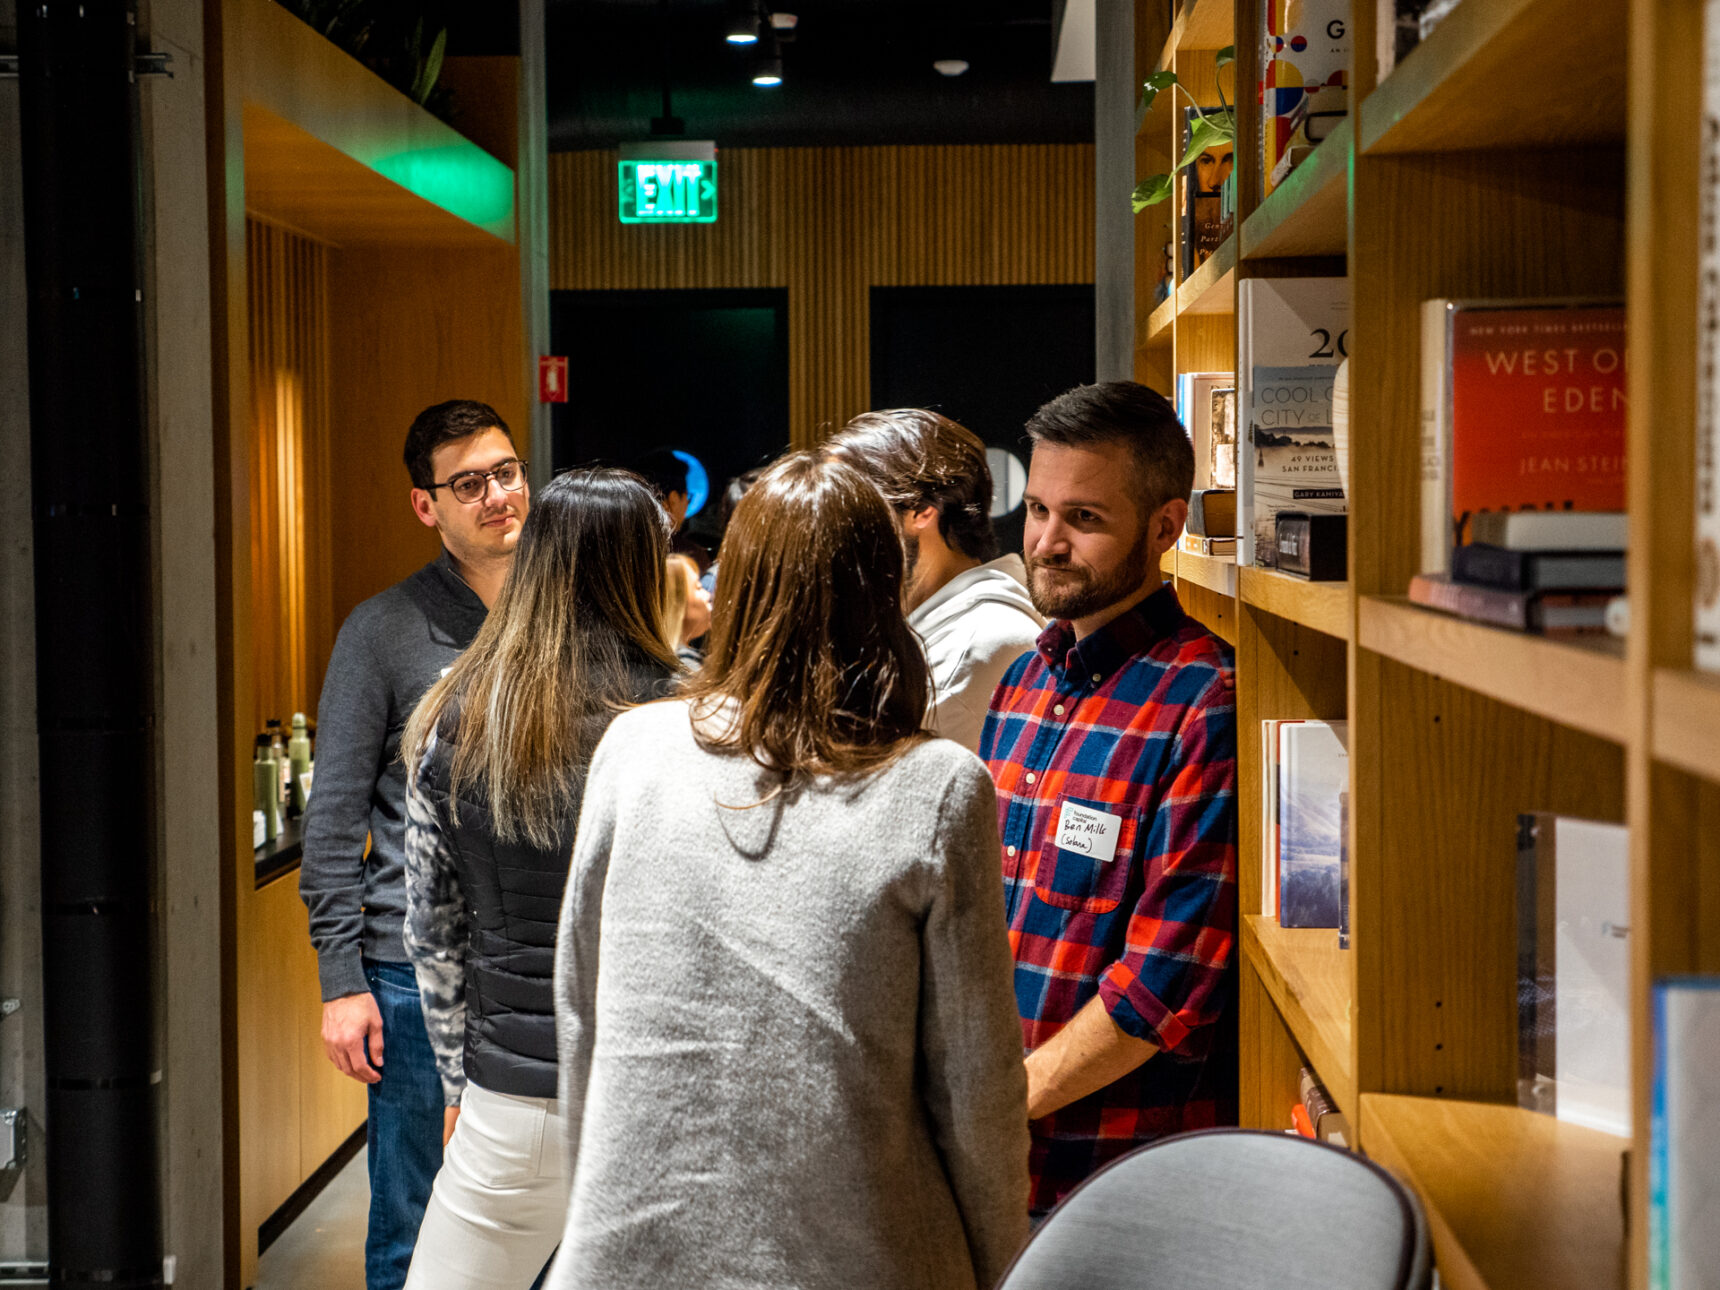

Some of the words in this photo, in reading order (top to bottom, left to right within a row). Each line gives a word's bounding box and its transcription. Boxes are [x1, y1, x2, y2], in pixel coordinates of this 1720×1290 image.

[636, 163, 703, 216] EXIT
[1485, 349, 1579, 375] WEST
[1593, 348, 1626, 374] O
[1261, 386, 1318, 404] COOL
[1261, 408, 1305, 425] CITY
[1519, 456, 1570, 475] JEAN
[1064, 819, 1082, 831] Ben
